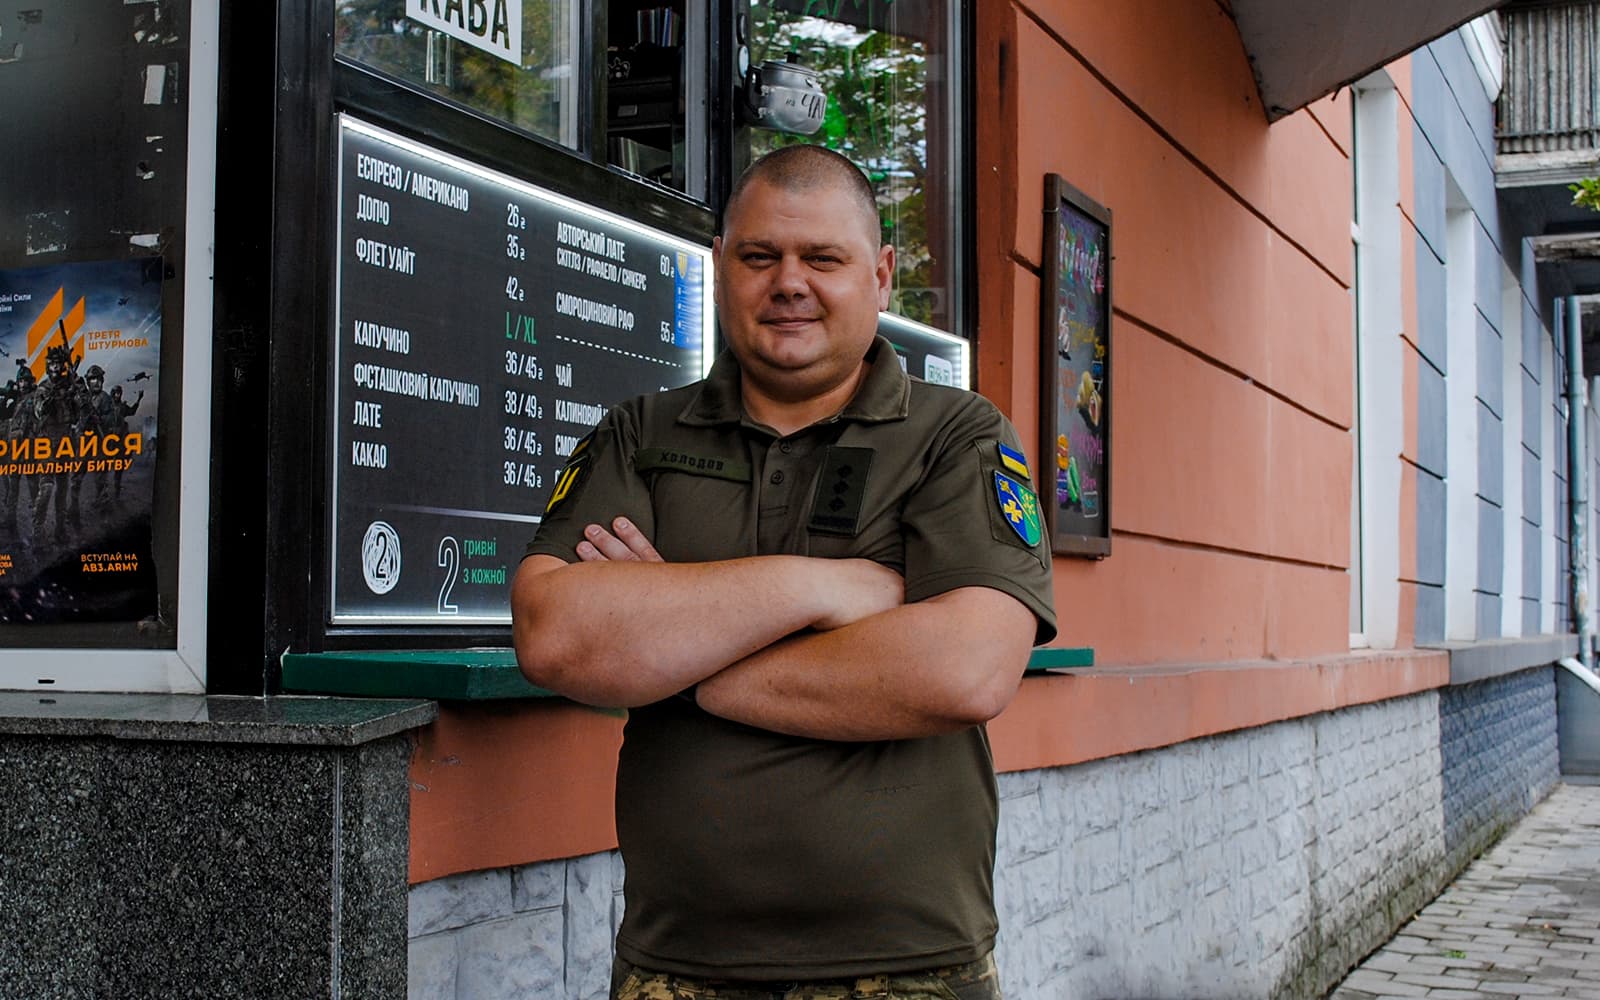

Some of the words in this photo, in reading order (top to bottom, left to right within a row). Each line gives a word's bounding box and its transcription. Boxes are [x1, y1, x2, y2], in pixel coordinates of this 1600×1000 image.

[356, 153, 403, 190] ЕСПРЕСО
[411, 172, 470, 212] АМЕРИКАНО
[556, 221, 606, 256] АВТОРСЬКИЙ
[606, 237, 626, 262] ЛАТЕ
[355, 238, 388, 268] ФЛЕТ
[388, 246, 416, 275] УАЙТ
[586, 257, 618, 282] РАФАЕЛО
[555, 291, 618, 328] СМОРОДИНОВИЙ
[618, 309, 634, 331] РАФ
[88, 330, 121, 340] ТРЕТЯ
[88, 338, 149, 350] ШТУРМОВА
[354, 320, 411, 355] КАПУЧИНО
[353, 362, 429, 400] ФІСТАШКОВИЙ
[429, 376, 480, 407] КАПУЧИНО
[555, 363, 573, 388] ЧАЙ
[353, 400, 383, 429] ЛАТЕ
[555, 399, 603, 427] КАЛИНОВИЙ
[87, 459, 133, 472] БИТВУ
[352, 440, 388, 469] КАКАО
[80, 552, 122, 562] ВСТУПАЙ
[124, 553, 138, 561] НА
[463, 537, 497, 559] гривні
[437, 535, 460, 614] 2
[472, 565, 507, 585] кожної
